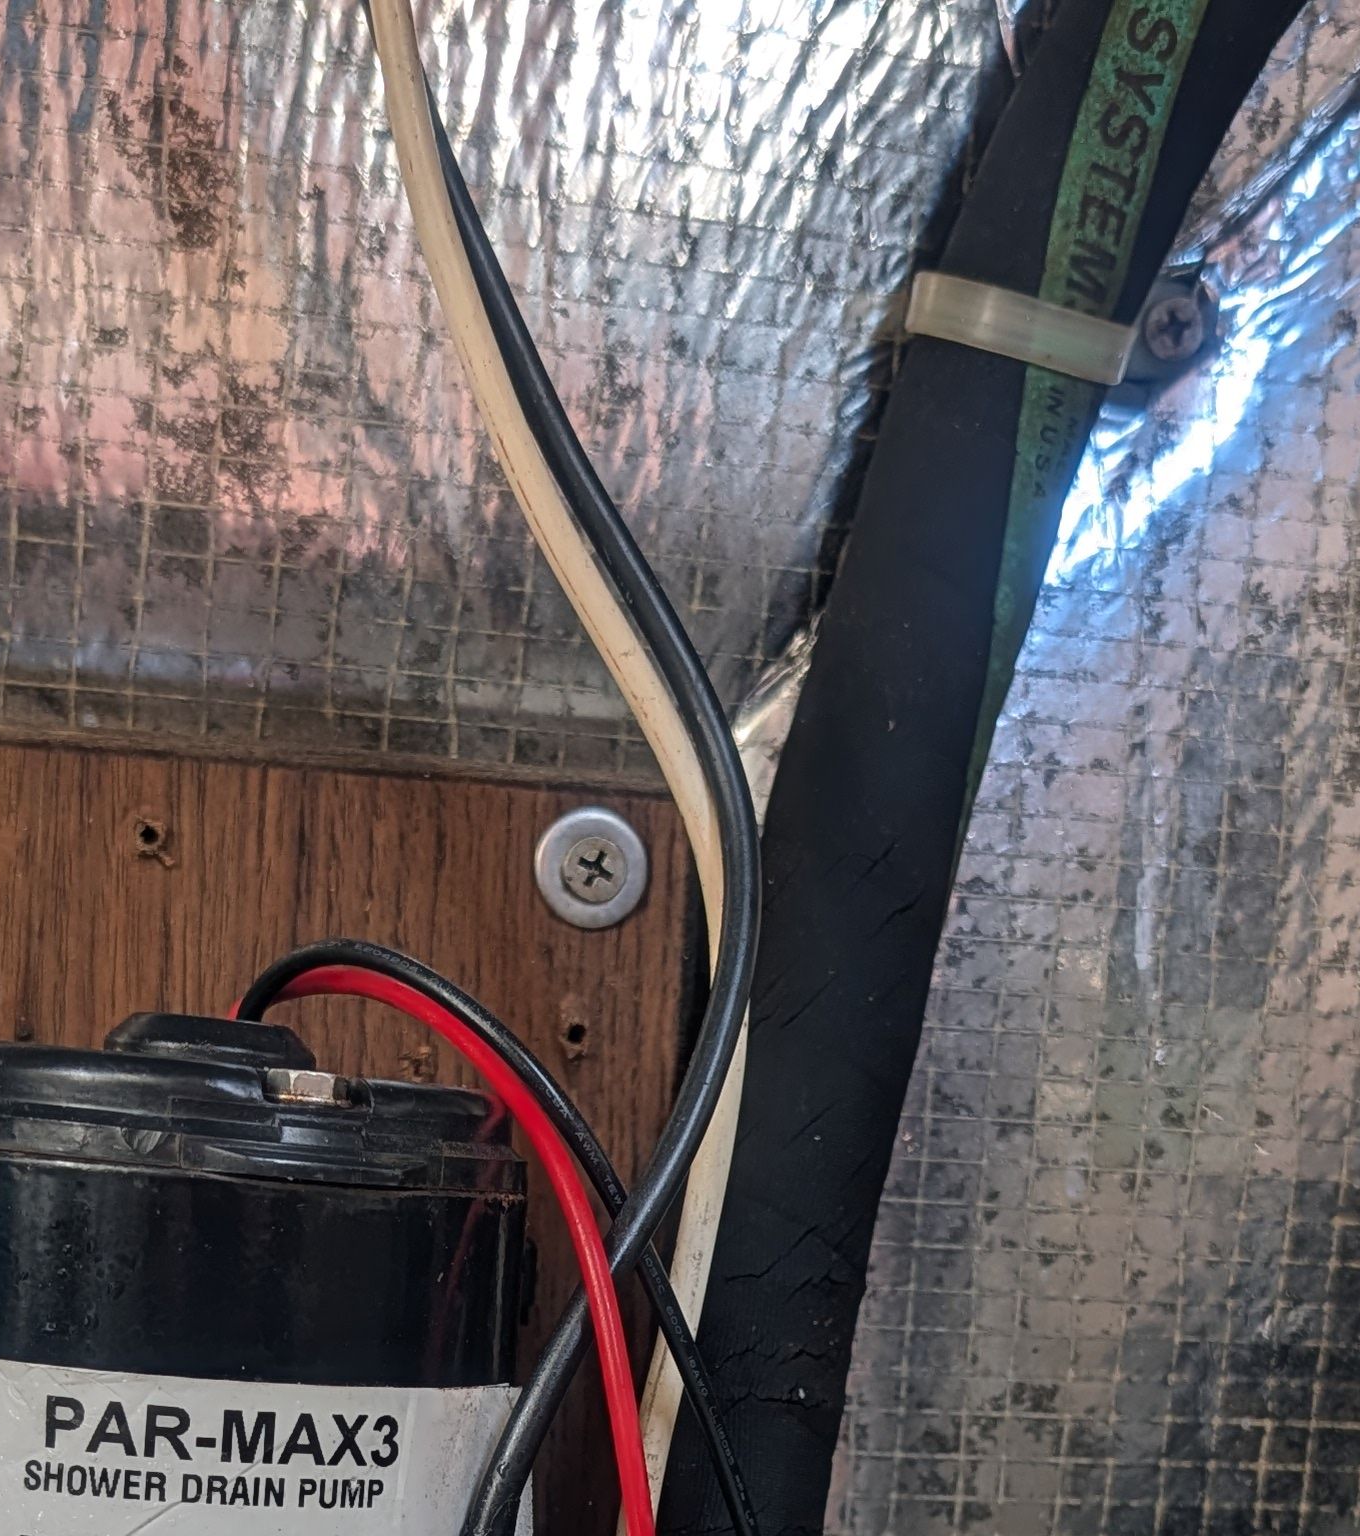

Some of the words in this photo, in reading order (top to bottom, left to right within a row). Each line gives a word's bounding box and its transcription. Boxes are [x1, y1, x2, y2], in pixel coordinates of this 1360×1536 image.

[1066, 13, 1178, 316] SYSTEM
[575, 1131, 601, 1166] AWM
[603, 1175, 624, 1206] TEW
[665, 1305, 689, 1344] 600V
[23, 1459, 168, 1502] SHOWER
[181, 1473, 286, 1508] DRAIN
[297, 1478, 385, 1510] PUMP
[44, 1394, 401, 1468] PAR-MAX3
